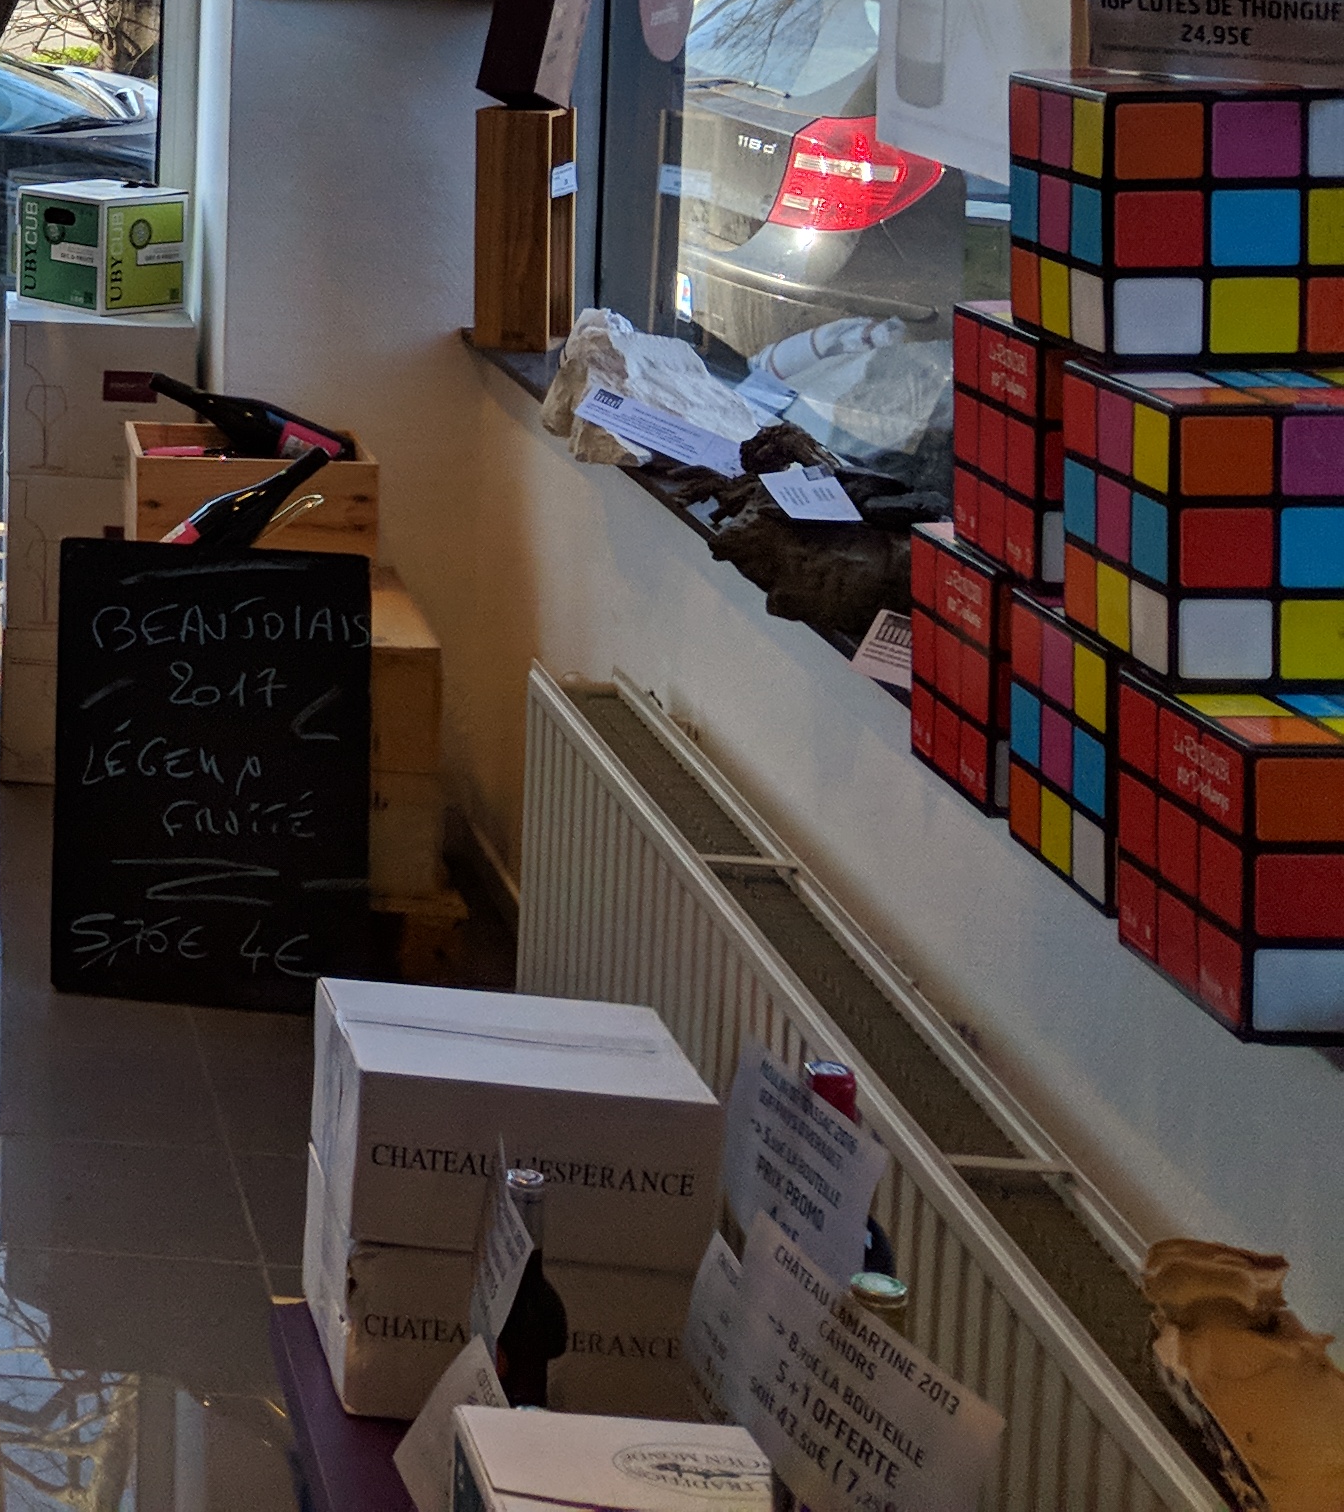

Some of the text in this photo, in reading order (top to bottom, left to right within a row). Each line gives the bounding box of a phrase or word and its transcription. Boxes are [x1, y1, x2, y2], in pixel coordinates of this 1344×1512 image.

[1180, 23, 1254, 47] 24,95€
[92, 596, 371, 652] BEAUJOLAIS
[169, 661, 288, 709] 2017
[240, 919, 321, 978] 4€
[371, 1143, 498, 1179] CHATEAU
[785, 1179, 825, 1232] PROMO
[363, 1313, 472, 1343] CHATEA
[819, 1319, 876, 1382] CAHORS
[830, 1294, 916, 1382] LAMARTINE
[917, 1372, 961, 1416] 2013
[813, 1397, 901, 1489] OFFERTE
[842, 1385, 926, 1468] BOUTEILLE
